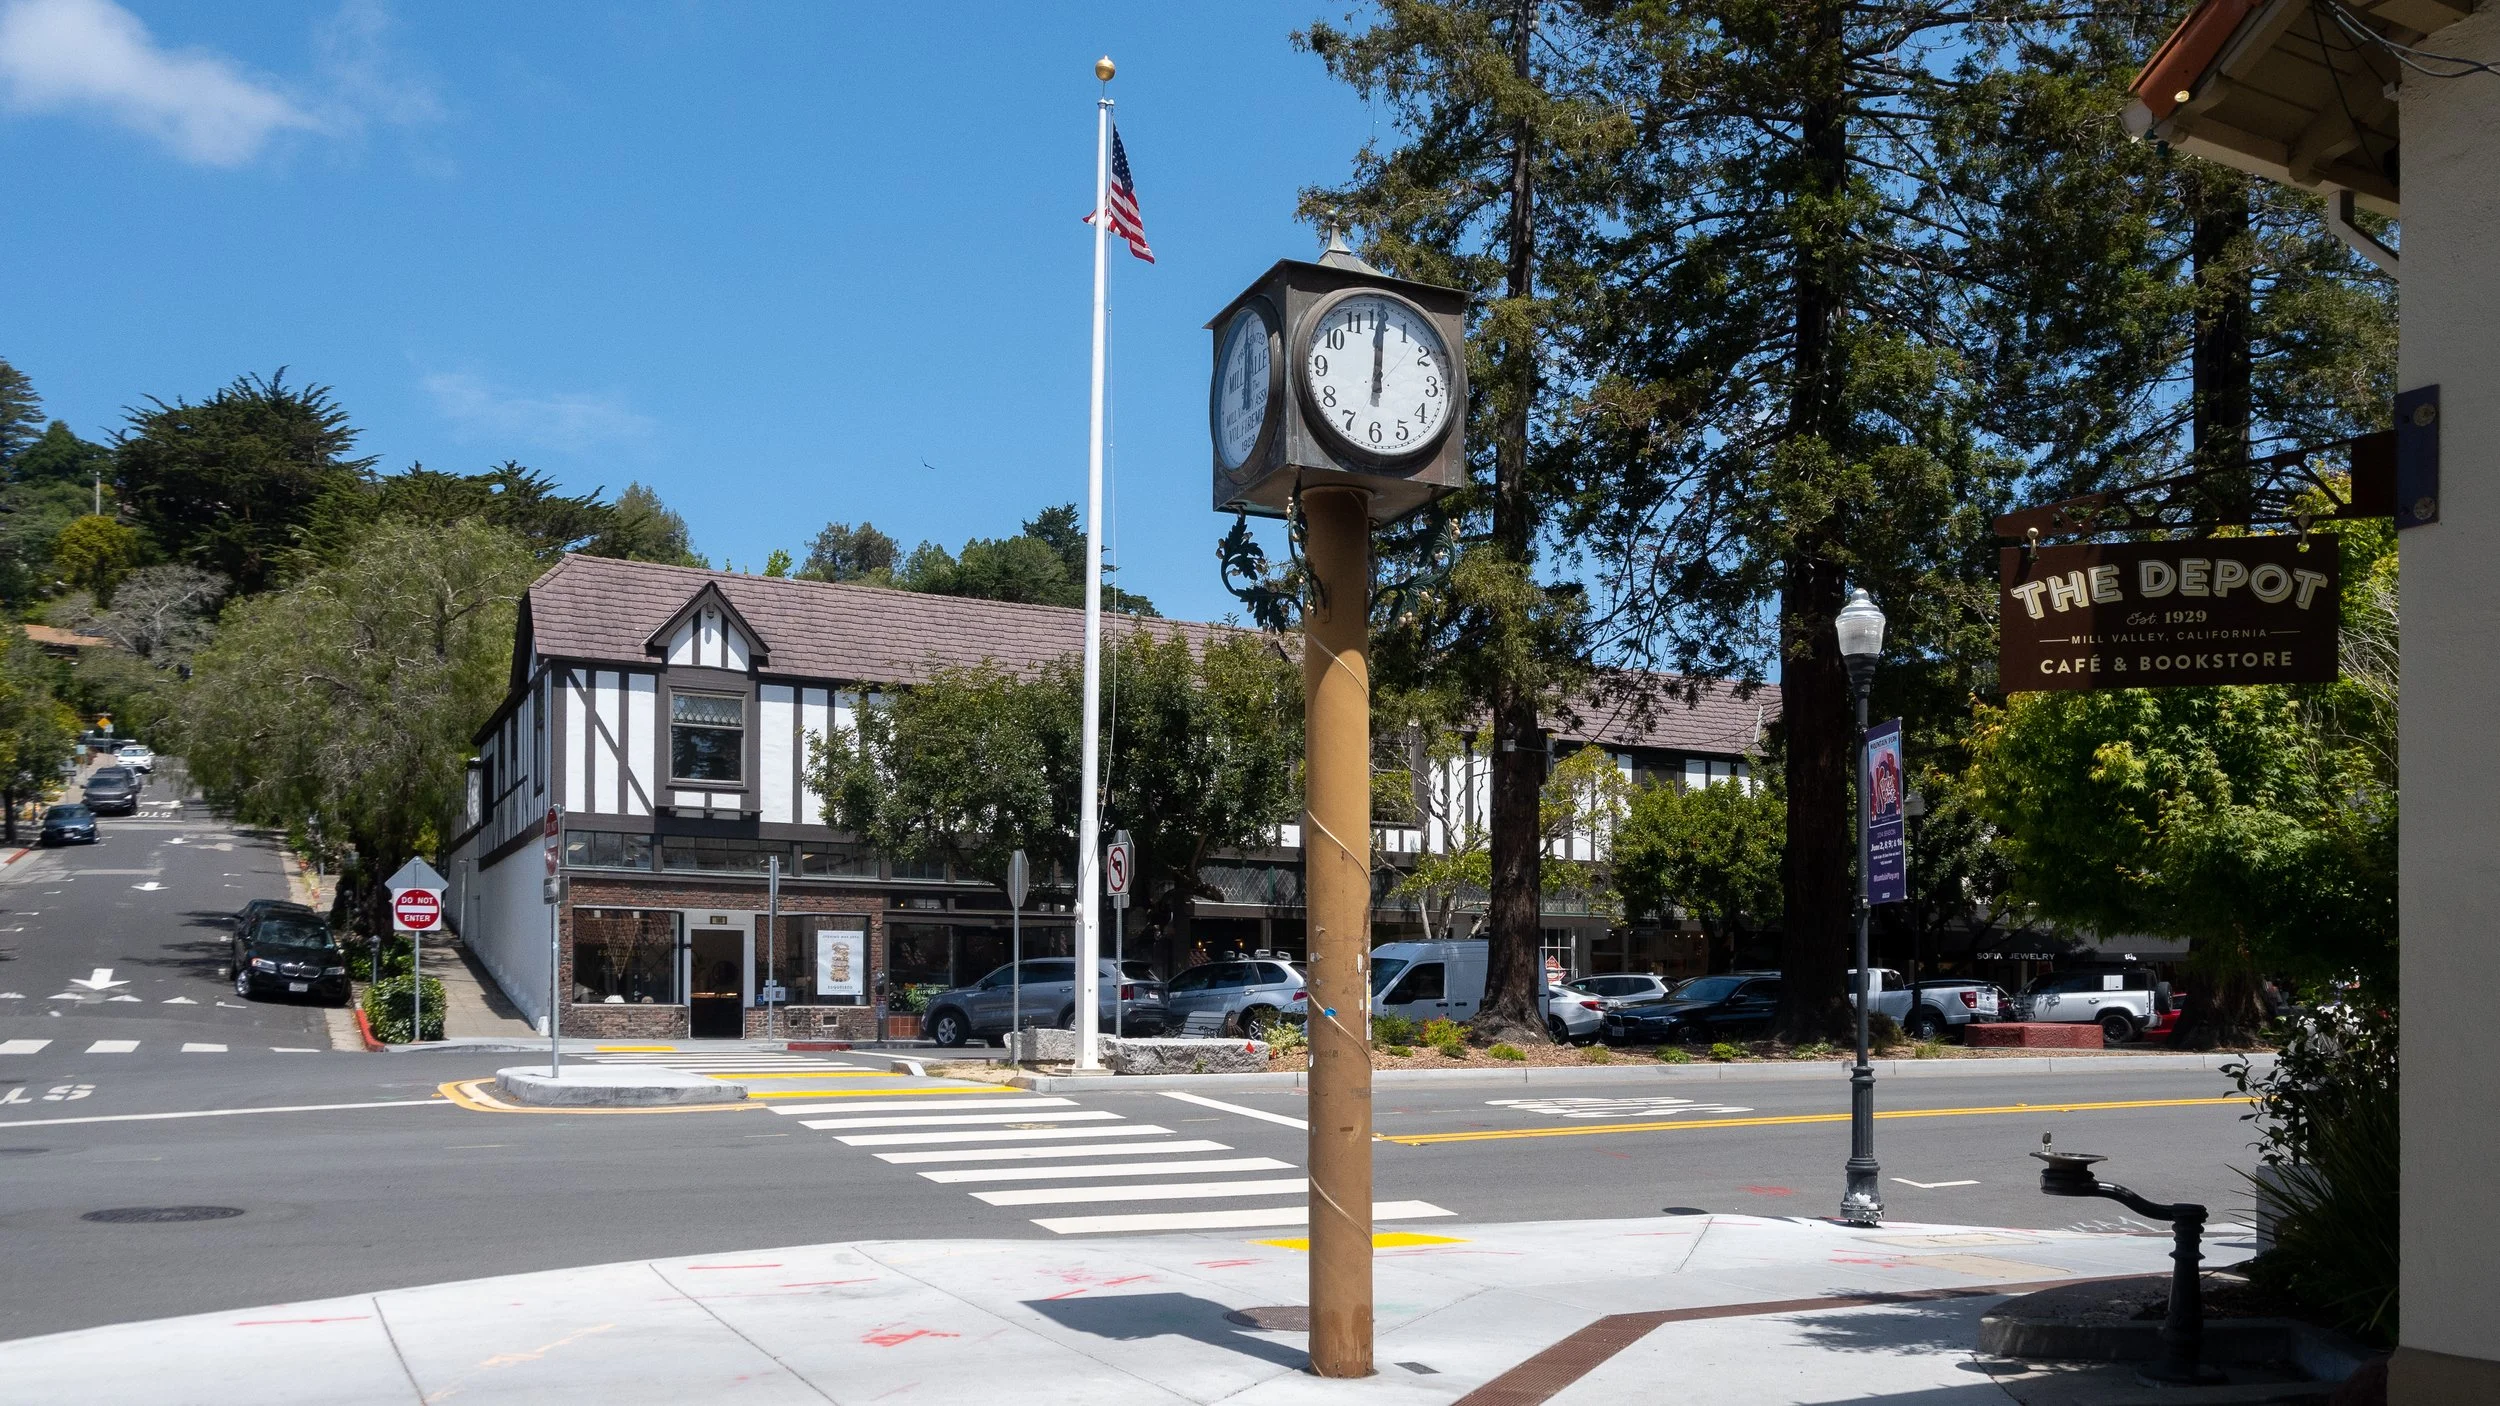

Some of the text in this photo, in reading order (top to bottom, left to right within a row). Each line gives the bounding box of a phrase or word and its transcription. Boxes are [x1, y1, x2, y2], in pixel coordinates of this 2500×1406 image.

[1346, 311, 1362, 335] 11
[1401, 322, 1408, 343] 1
[1325, 327, 1345, 350] 10
[1314, 354, 1328, 377] 9
[1417, 345, 1430, 367] 2
[1322, 385, 1336, 408] 8
[1425, 376, 1438, 398] 3
[1342, 409, 1356, 432] 7
[1414, 402, 1427, 424] 4
[1368, 421, 1382, 444] 6
[1395, 419, 1409, 441] 5
[2010, 558, 2328, 620] THE DEPOT
[2165, 610, 2207, 624] 1929
[2071, 628, 2267, 645] MILL VALLEY, CALIFORNIA
[2040, 651, 2293, 675] CAFÉ & BOOKSTORE
[401, 896, 433, 904] DO NOT
[404, 914, 430, 922] ENTER
[1976, 952, 2056, 960] SOFIA JEWELRY
